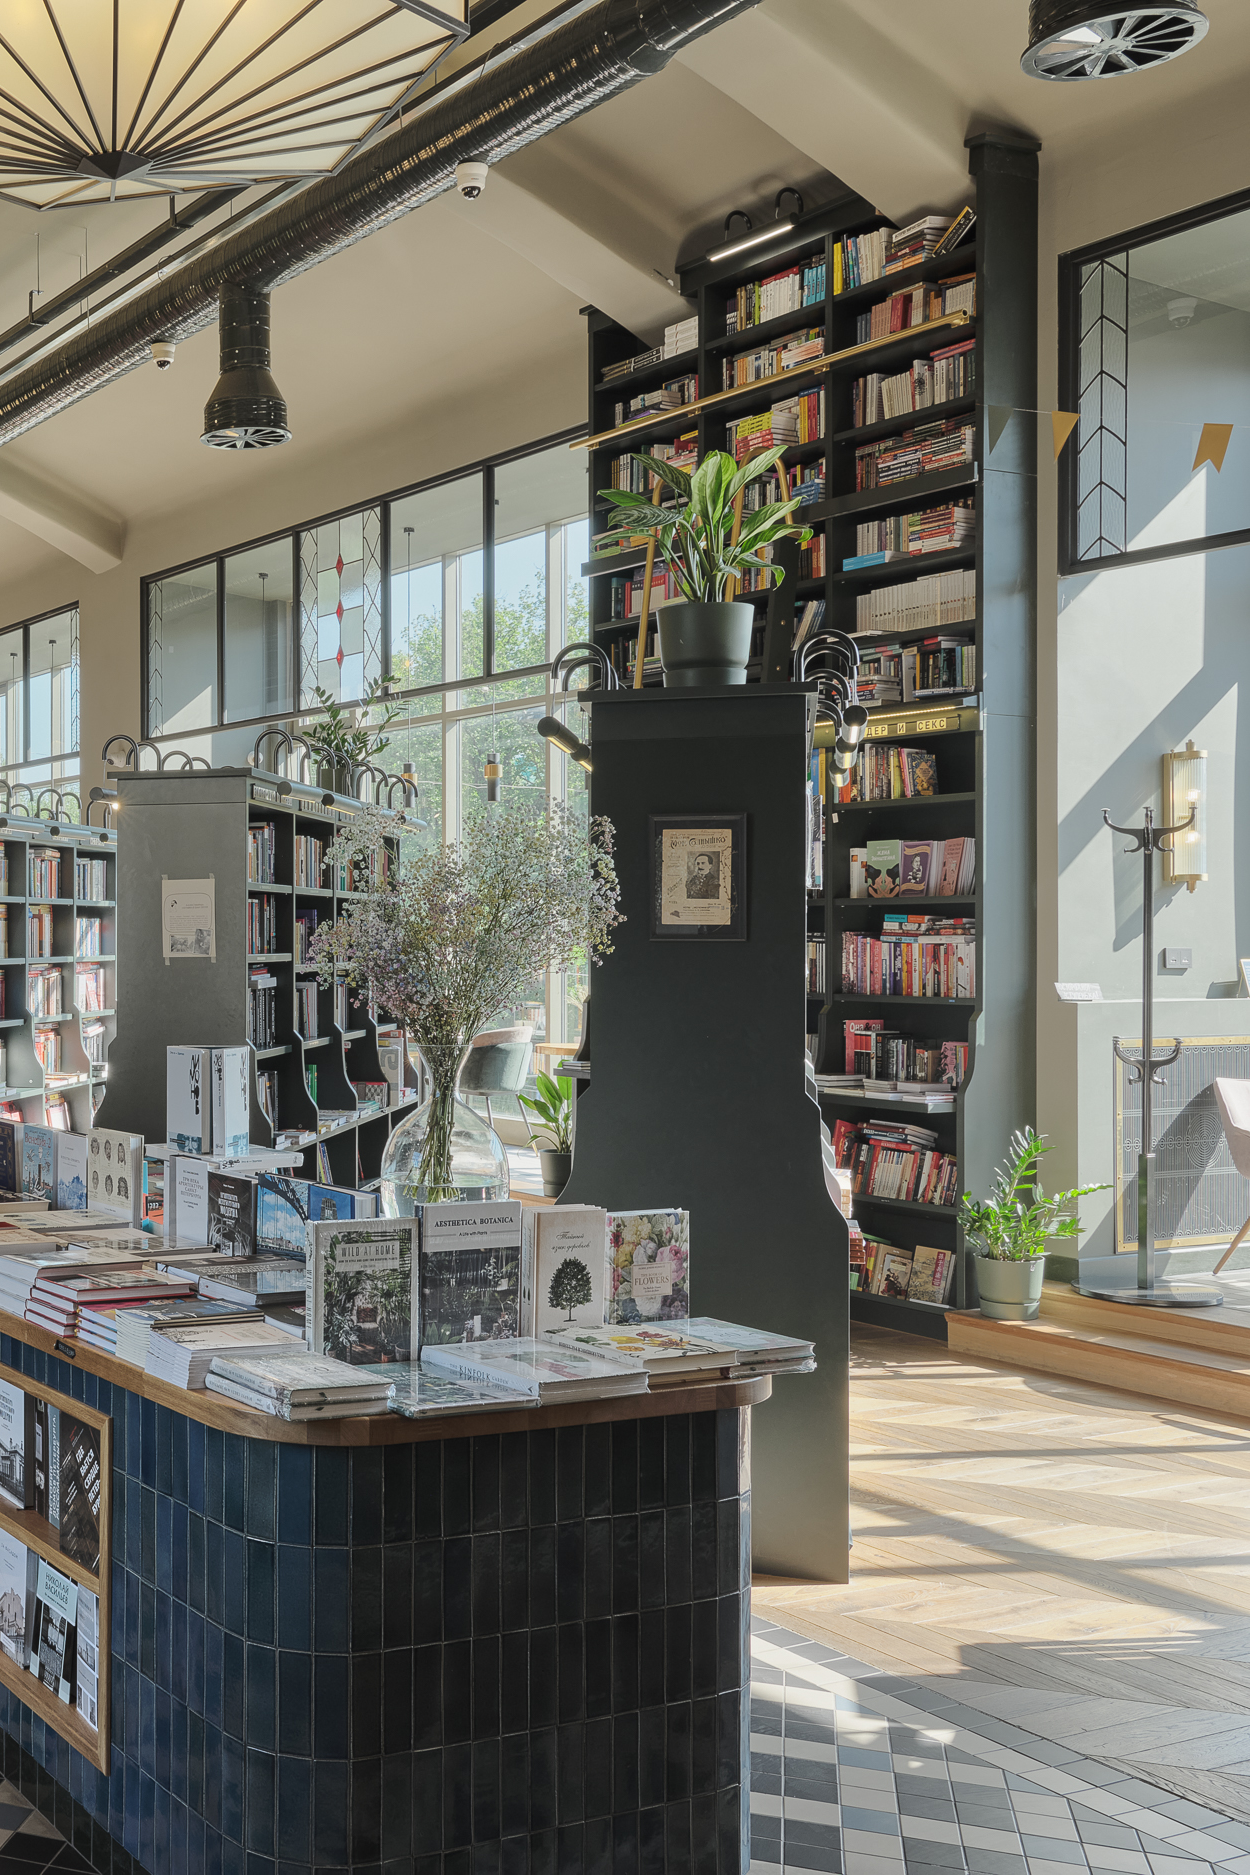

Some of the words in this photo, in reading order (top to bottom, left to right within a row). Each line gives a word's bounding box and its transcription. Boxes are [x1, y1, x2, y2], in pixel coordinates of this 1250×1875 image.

[898, 724, 904, 732] И
[917, 718, 945, 730] СЕКС
[434, 1219, 477, 1228] AESTHETICA
[341, 1246, 360, 1257] WILD
[364, 1245, 372, 1256] AT
[375, 1244, 395, 1256] HOME
[634, 1276, 670, 1286] FLOWERS
[459, 1364, 491, 1382] KINFOLK
[75, 1445, 85, 1463] ГДЕ
[84, 1460, 100, 1489] СЕРДЦЕ
[45, 1572, 70, 1595] НИКОЛАЙ
[45, 1581, 68, 1605] ВАСИЛЬЕВ
